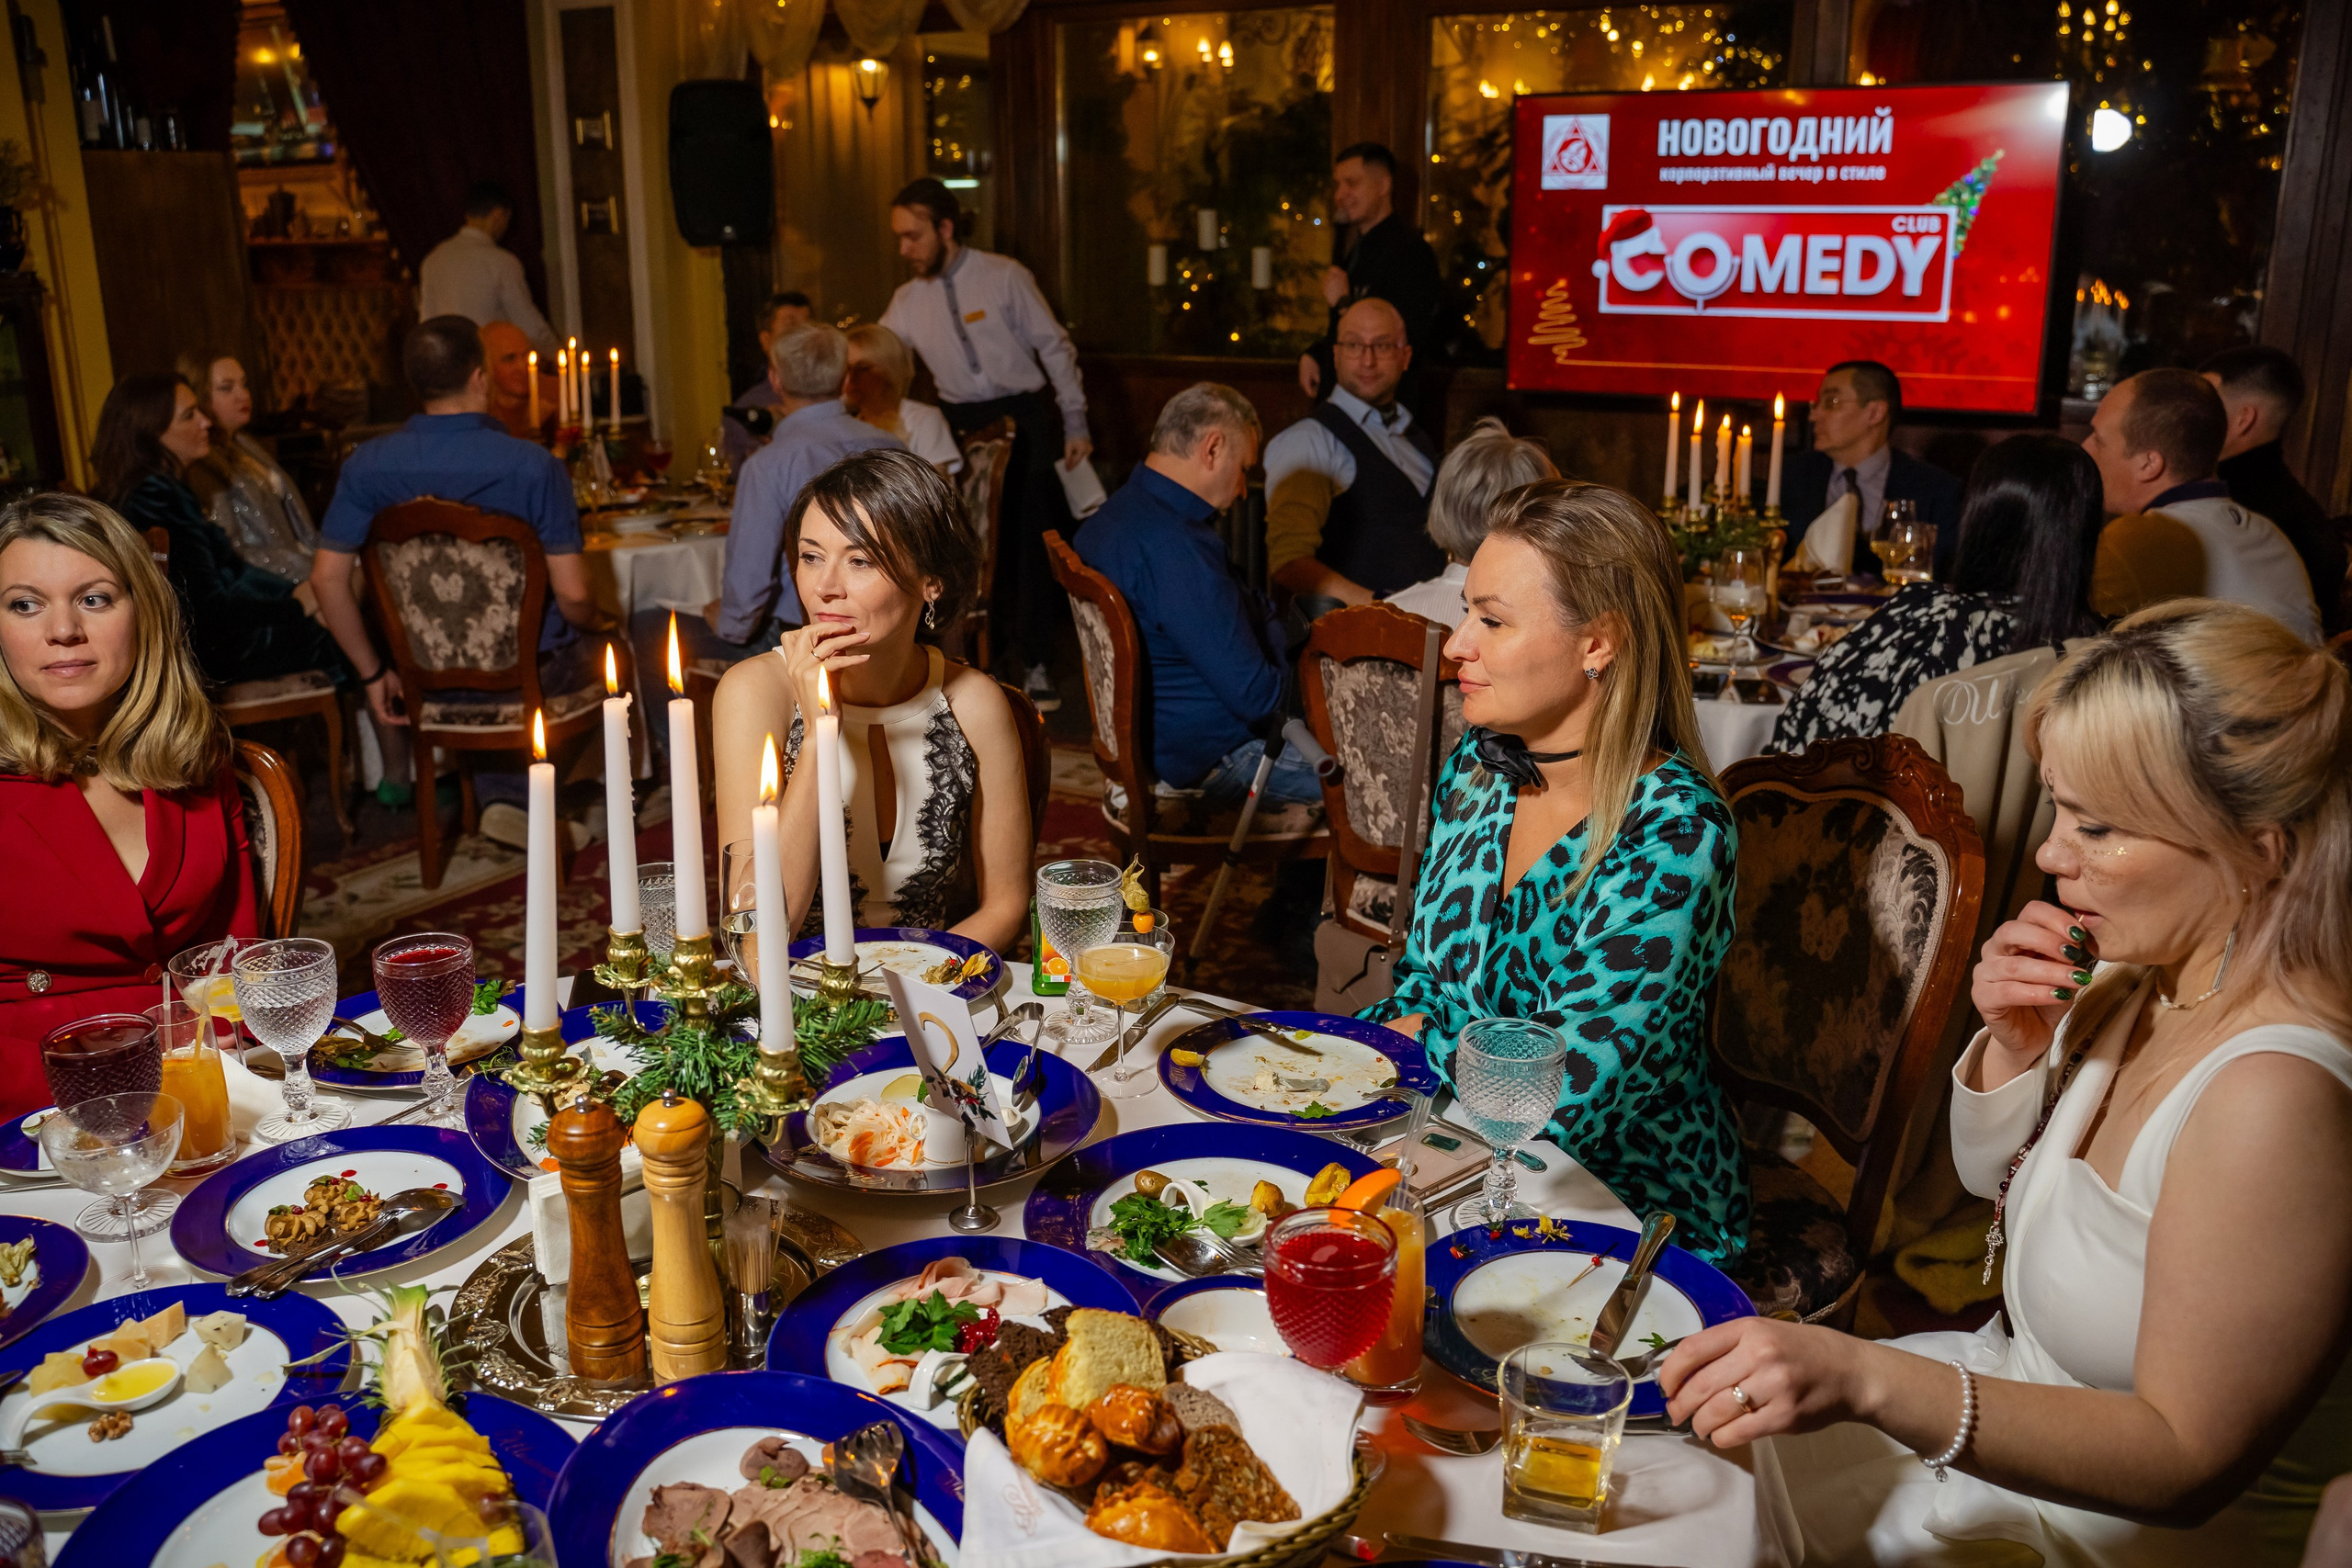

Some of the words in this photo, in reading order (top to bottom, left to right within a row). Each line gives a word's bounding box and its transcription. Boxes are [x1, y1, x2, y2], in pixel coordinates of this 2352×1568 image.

[1657, 107, 1894, 162] НОВОГОДНИЙ
[1778, 166, 1824, 184] вечер
[1839, 165, 1886, 181] стиле
[1892, 215, 1941, 233] CLUB
[1611, 231, 1942, 298] COMEDY
